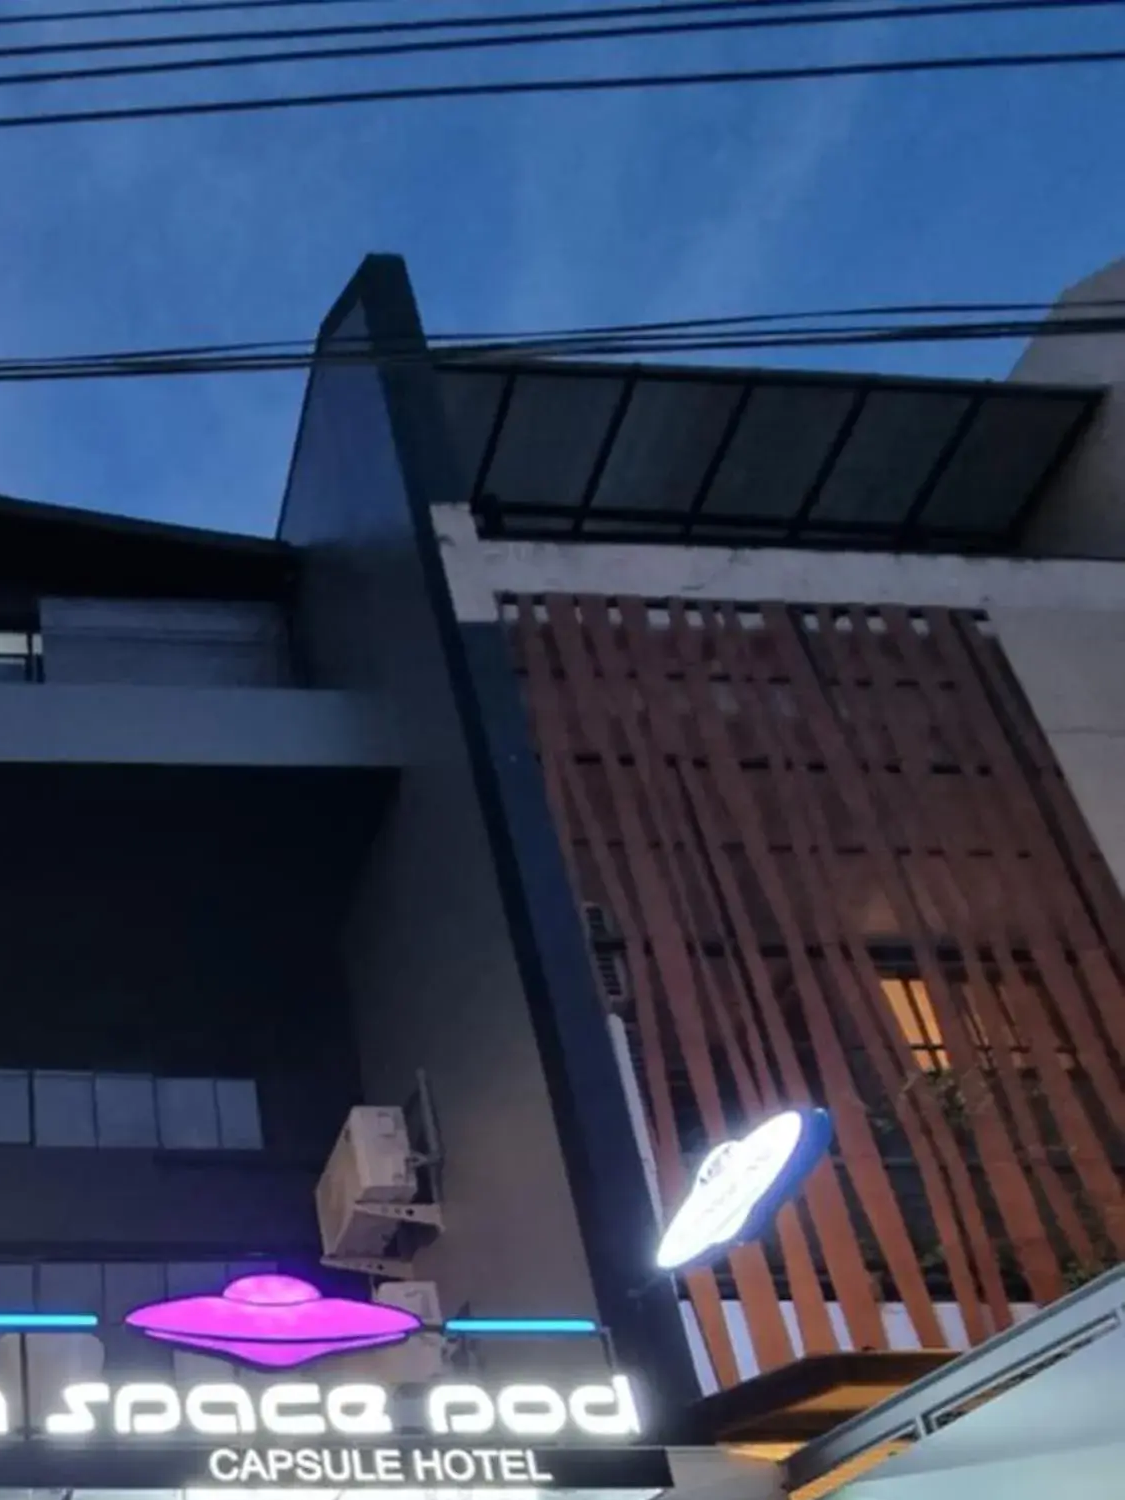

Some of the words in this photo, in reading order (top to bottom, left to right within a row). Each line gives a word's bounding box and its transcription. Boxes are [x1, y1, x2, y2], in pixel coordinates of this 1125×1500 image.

[45, 1383, 392, 1434] space
[427, 1375, 641, 1435] pod
[209, 1448, 404, 1481] CAPSULE
[413, 1449, 553, 1481] HOTEL
